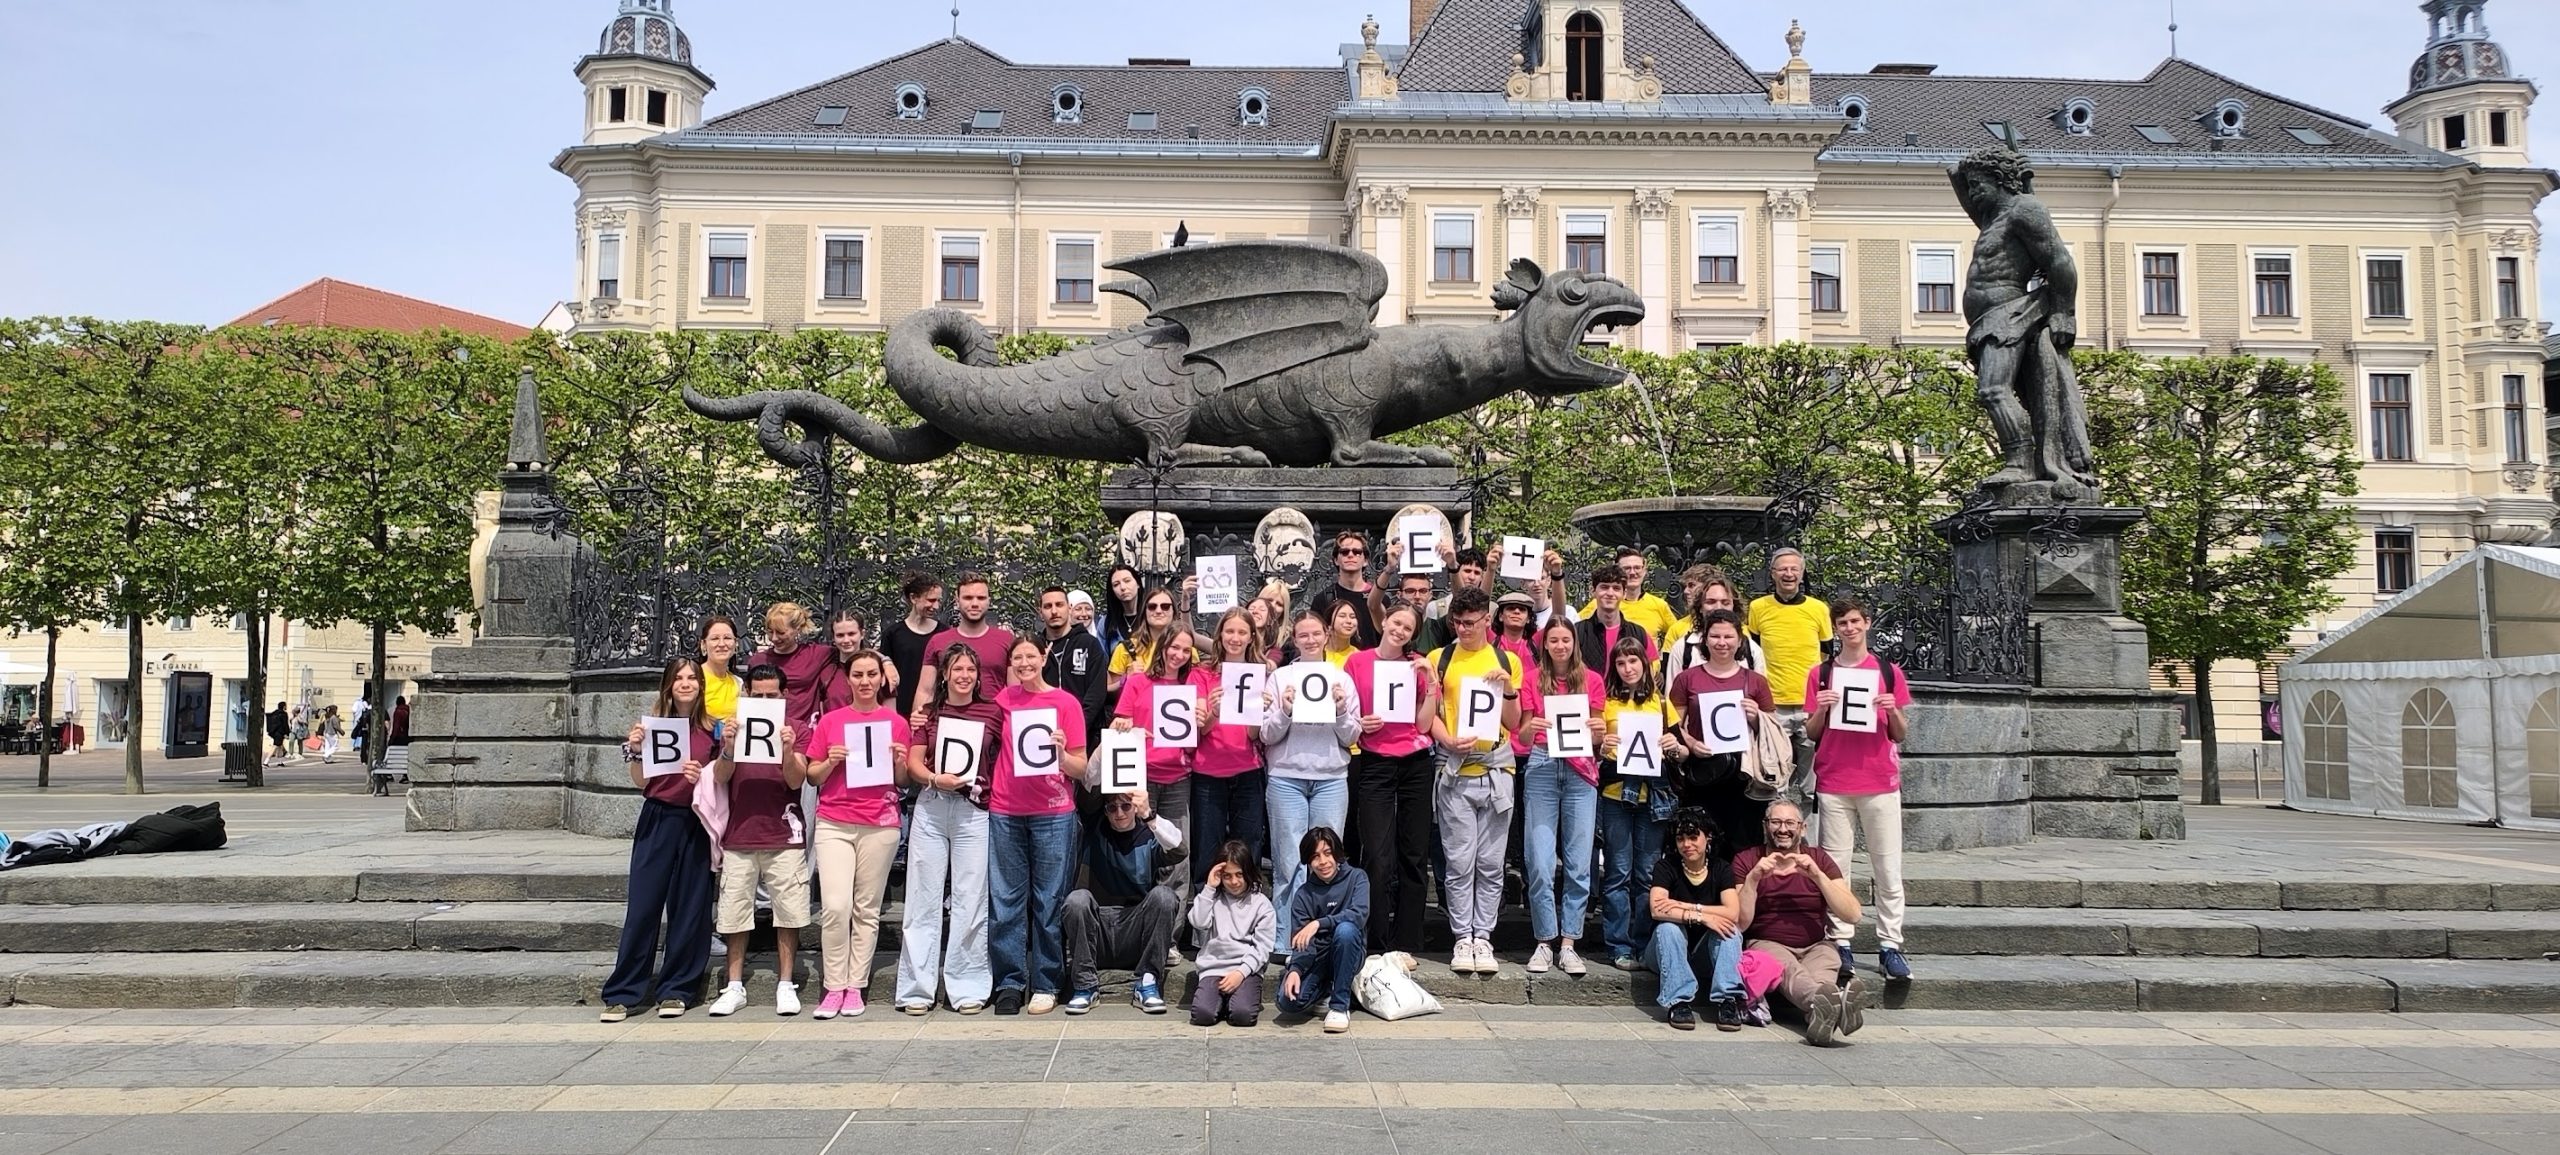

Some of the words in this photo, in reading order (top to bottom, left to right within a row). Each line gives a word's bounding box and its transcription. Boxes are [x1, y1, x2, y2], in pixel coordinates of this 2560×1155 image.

[1409, 532, 1433, 567] E
[146, 662, 199, 675] ELEGANZA
[1302, 674, 1328, 701] o
[1236, 673, 1253, 713] f
[1389, 683, 1403, 710] r
[1469, 690, 1494, 727] P
[1842, 687, 1868, 725] E
[745, 718, 775, 757] R
[1160, 699, 1191, 740] S
[1557, 714, 1583, 751] E
[1711, 703, 1740, 741] C
[652, 730, 681, 764] B
[941, 738, 973, 777] D
[1018, 724, 1057, 768] G
[1623, 731, 1654, 769] A
[1113, 748, 1137, 787] E
